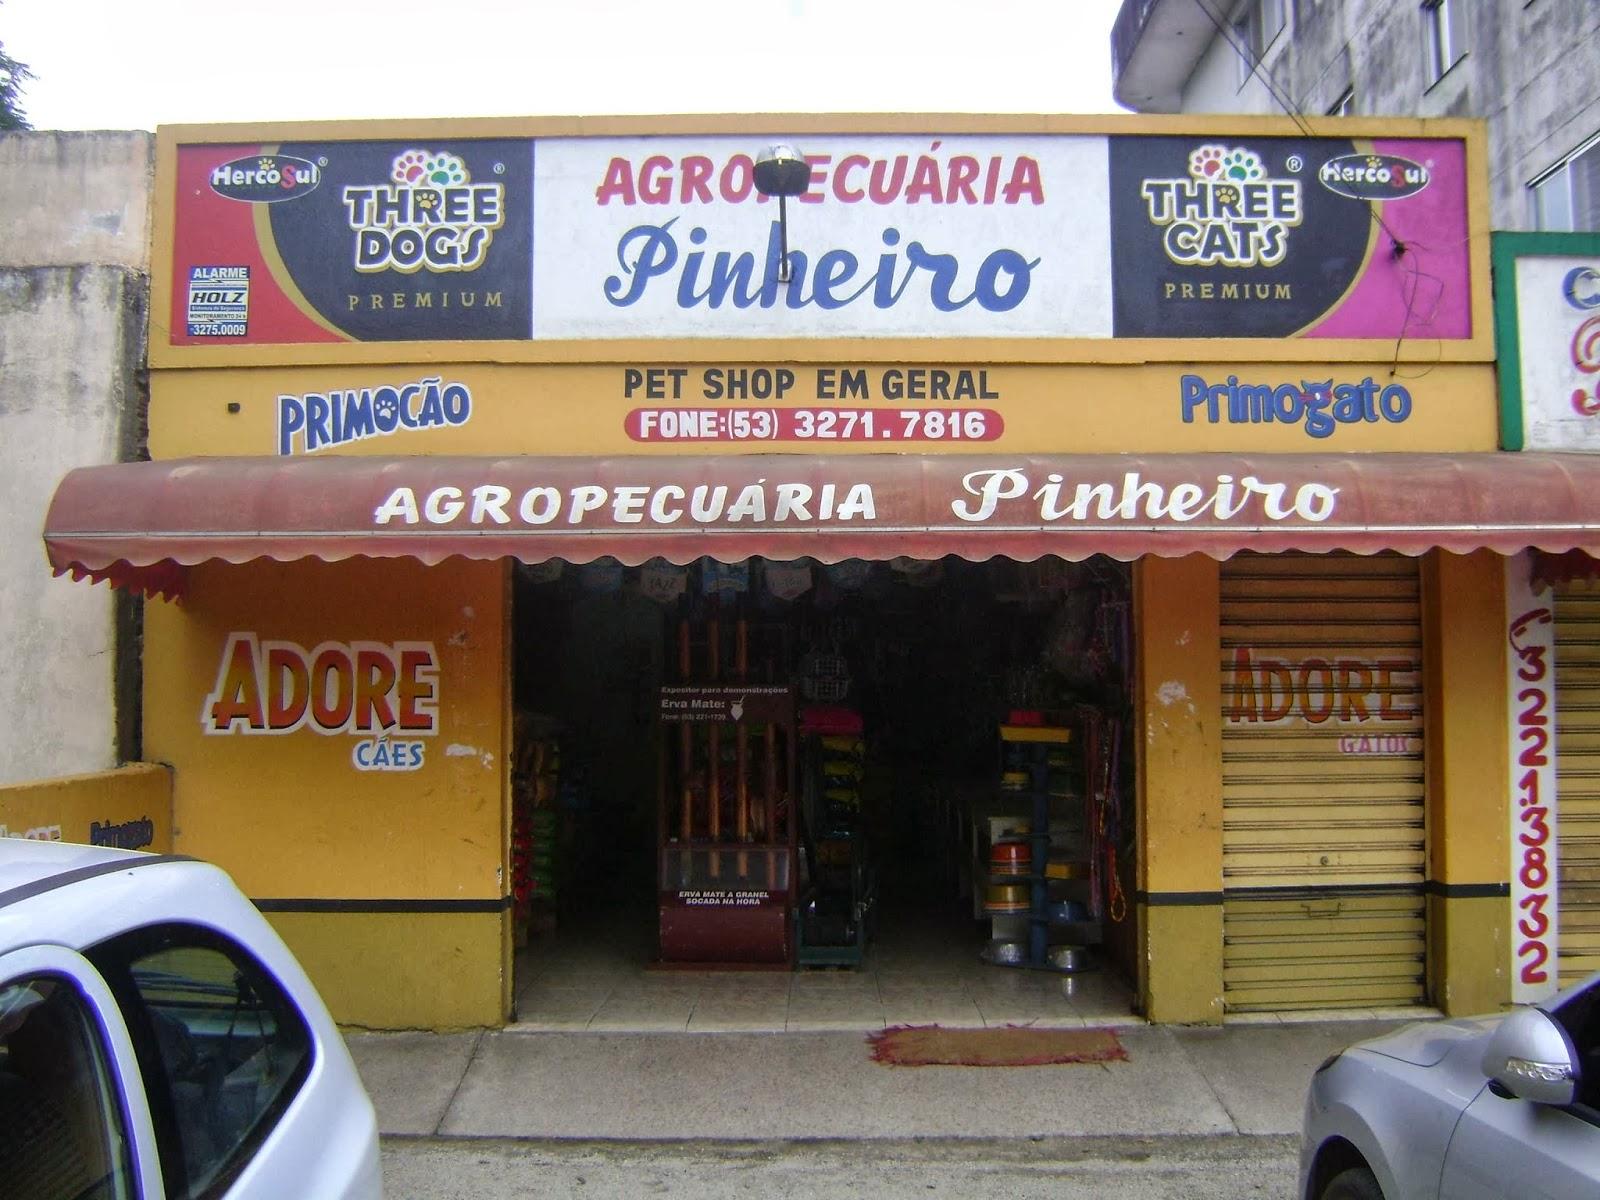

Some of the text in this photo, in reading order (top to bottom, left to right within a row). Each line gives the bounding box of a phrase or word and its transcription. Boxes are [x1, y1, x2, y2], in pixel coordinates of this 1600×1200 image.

[211, 164, 320, 190] HercoSul
[596, 140, 1046, 206] AGROECUÁRIA
[341, 183, 506, 231] THREE
[1141, 178, 1304, 226] THREE
[602, 215, 1043, 313] Pinheiro
[1164, 222, 1288, 266] CATS
[193, 267, 248, 279] ALARME
[1164, 283, 1292, 300] PREMIUM
[192, 292, 245, 304] HOLZ
[349, 291, 503, 311] PREMIUM
[193, 324, 246, 336] 3275.0009
[624, 368, 999, 400] PET SHOP EM GERAL
[1180, 374, 1412, 438] Primogato
[277, 376, 471, 456] PRIMOCÃO
[374, 478, 877, 525] AGROPECUÁRIA
[950, 467, 1341, 522] Pinheiro
[201, 631, 440, 736] ADORE
[661, 699, 725, 709] Erva Mate:
[1224, 648, 1414, 724] ADORE
[735, 891, 769, 899] GRANEL
